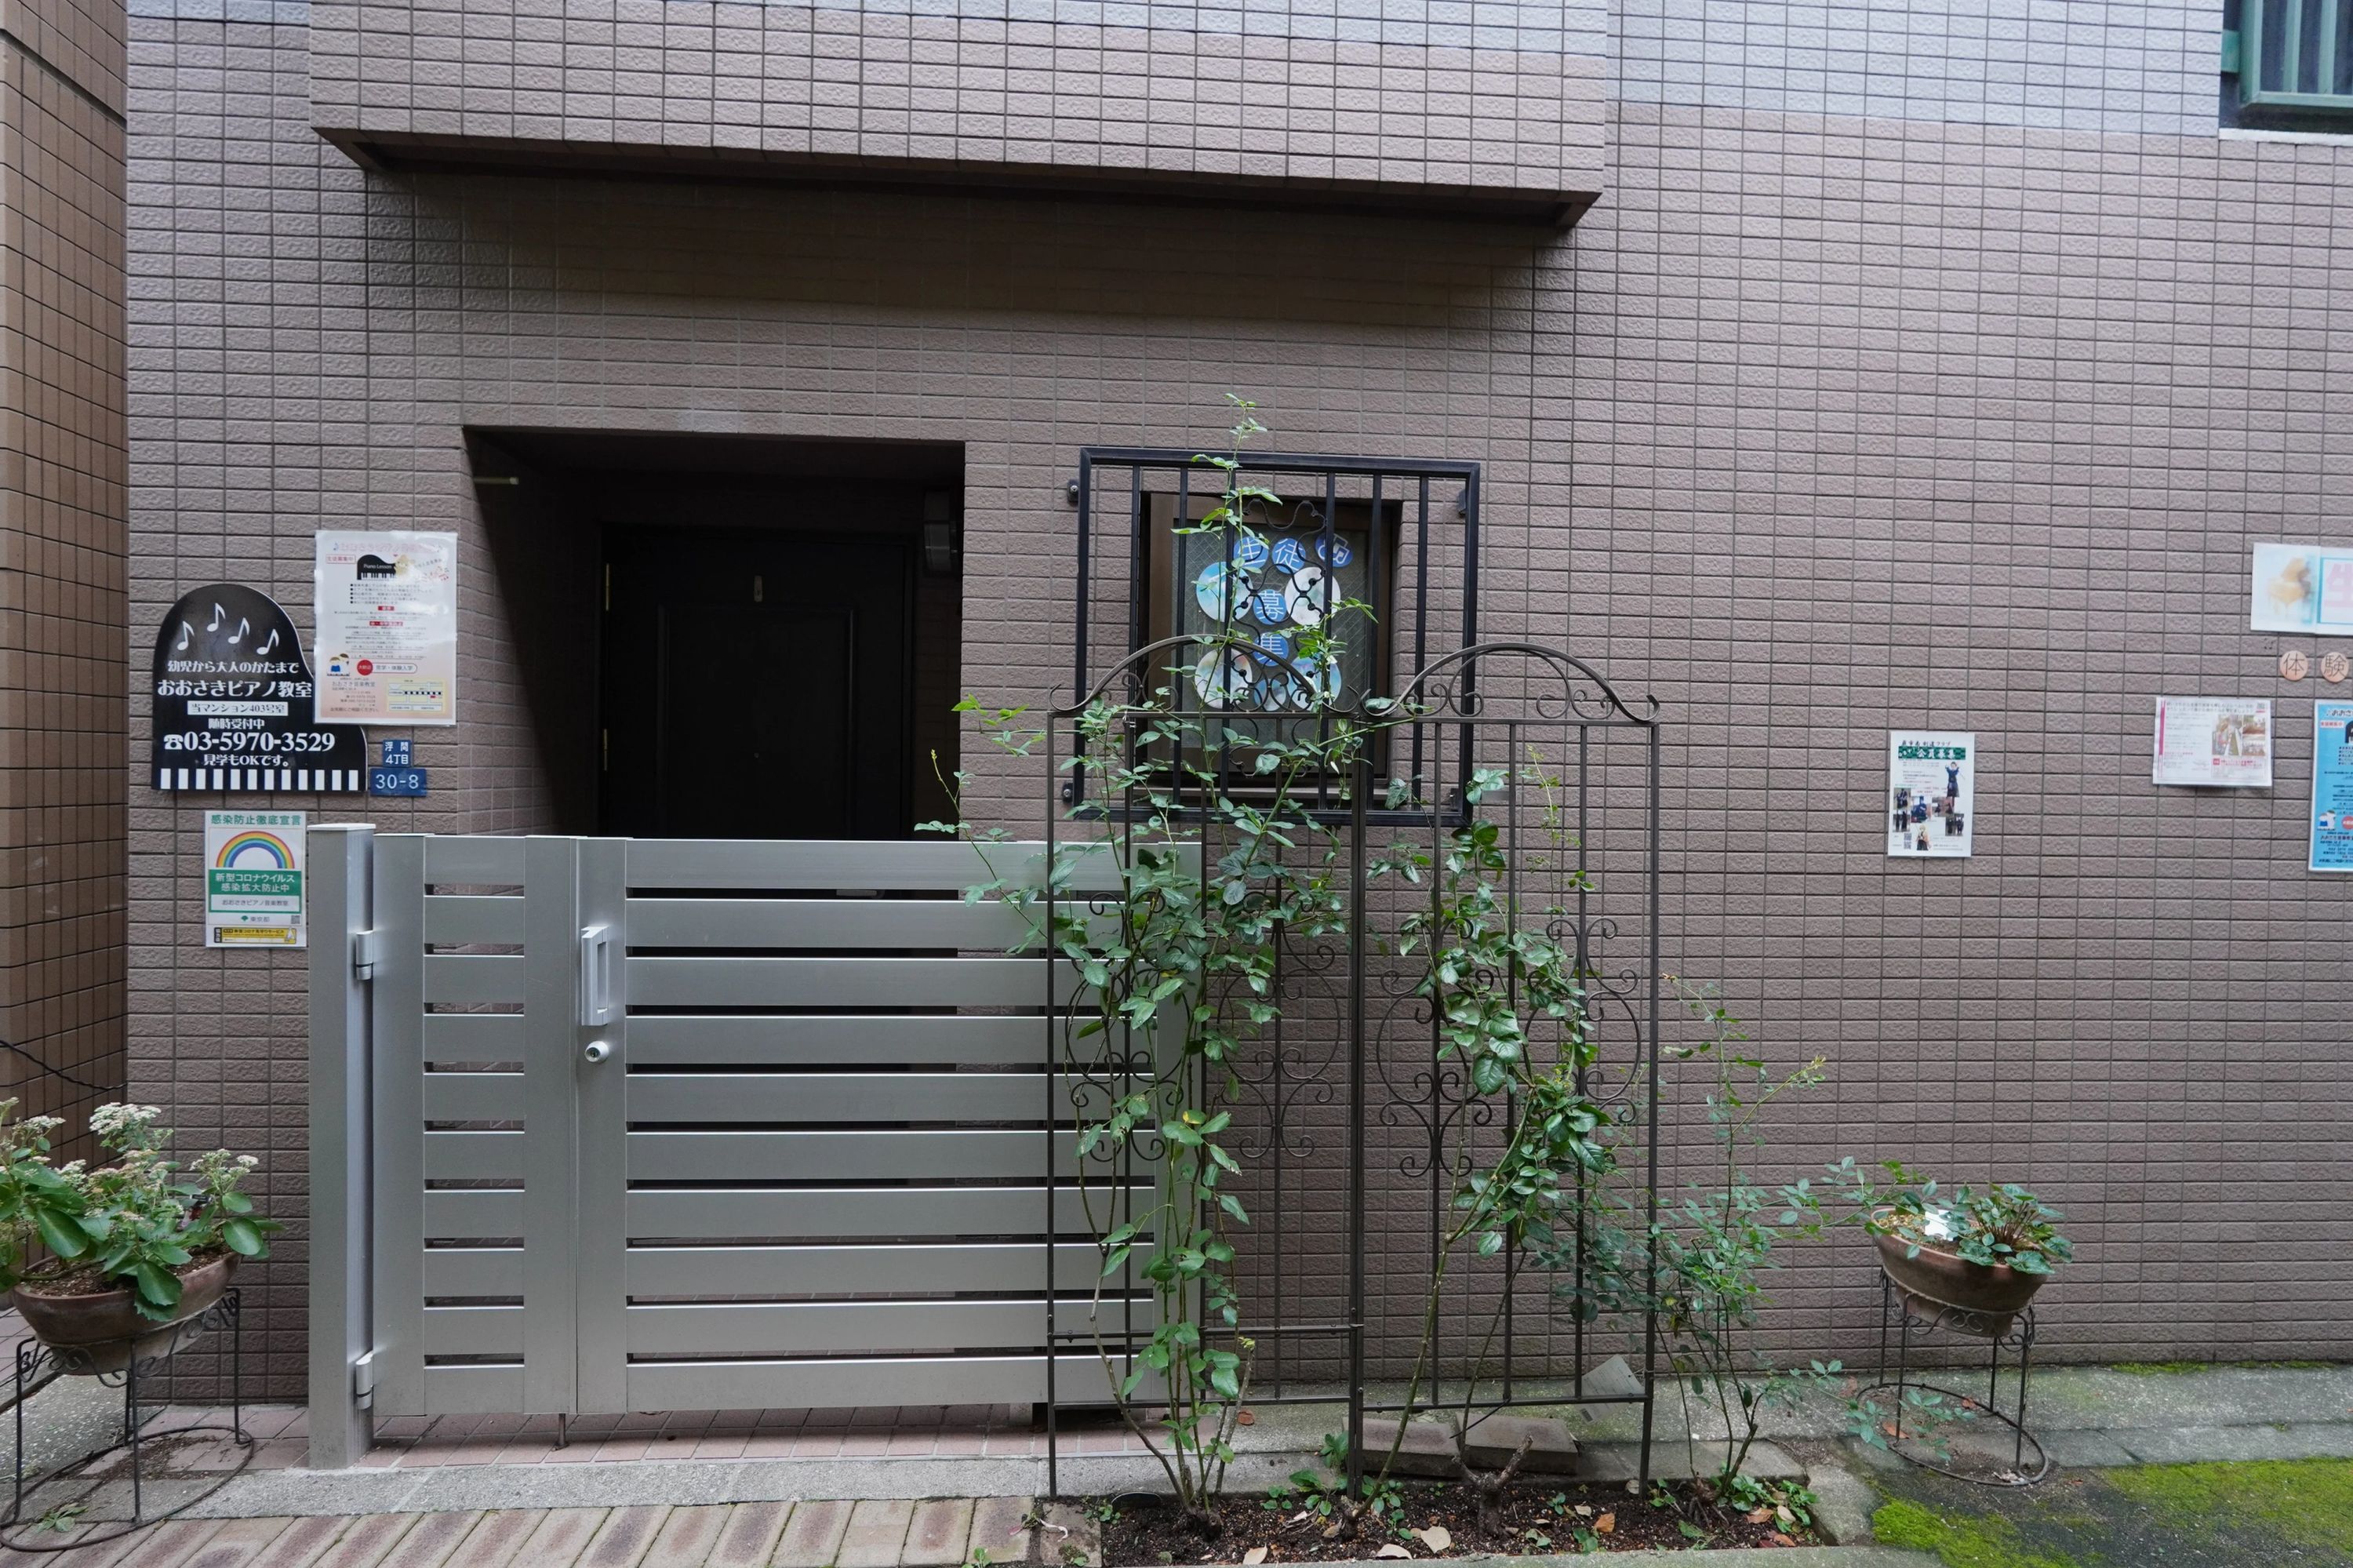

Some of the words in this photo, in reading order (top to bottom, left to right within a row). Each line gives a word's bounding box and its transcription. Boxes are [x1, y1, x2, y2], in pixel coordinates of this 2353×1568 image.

[167, 660, 299, 674] 幼児から大人のかたまで
[157, 679, 312, 698] おおさきピアノ教室
[191, 703, 285, 715] 当マンション403号室
[208, 718, 265, 729] 随時受付中
[184, 732, 335, 752] 03-5970-3529
[385, 741, 409, 751] 浮間
[203, 754, 289, 767] 見学もOKです。
[385, 754, 409, 765] 4丁目
[375, 774, 419, 789] 30-8
[211, 814, 301, 825] 感染防止徹底宣言
[215, 873, 295, 882] 新型コロナウイルス
[221, 882, 289, 893] 感染拡大防止中
